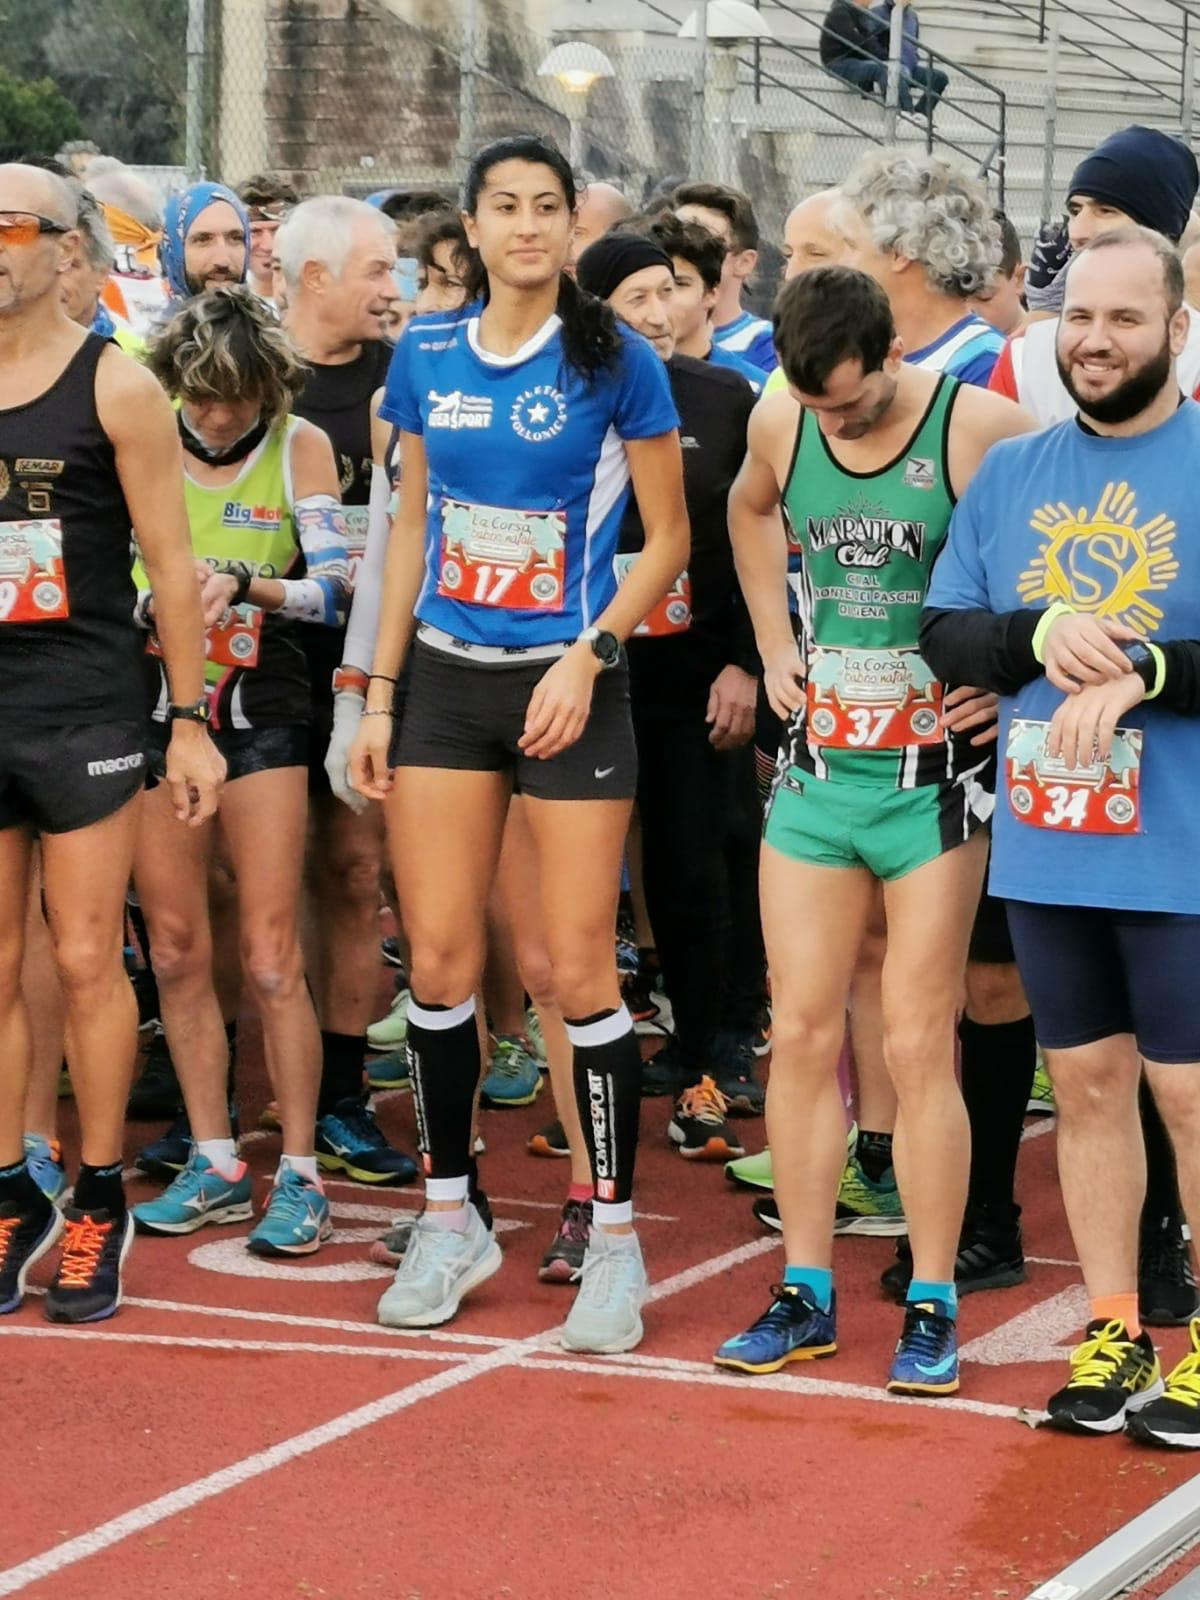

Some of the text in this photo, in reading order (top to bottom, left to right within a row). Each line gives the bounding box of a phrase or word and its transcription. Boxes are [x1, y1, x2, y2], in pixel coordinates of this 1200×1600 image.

[491, 516, 532, 533] Corsa
[807, 513, 926, 562] MARATHON
[836, 541, 891, 569] Club
[474, 565, 518, 605] 17
[844, 657, 907, 671] La Corsa
[846, 708, 897, 747] 37
[1043, 785, 1090, 828] 34
